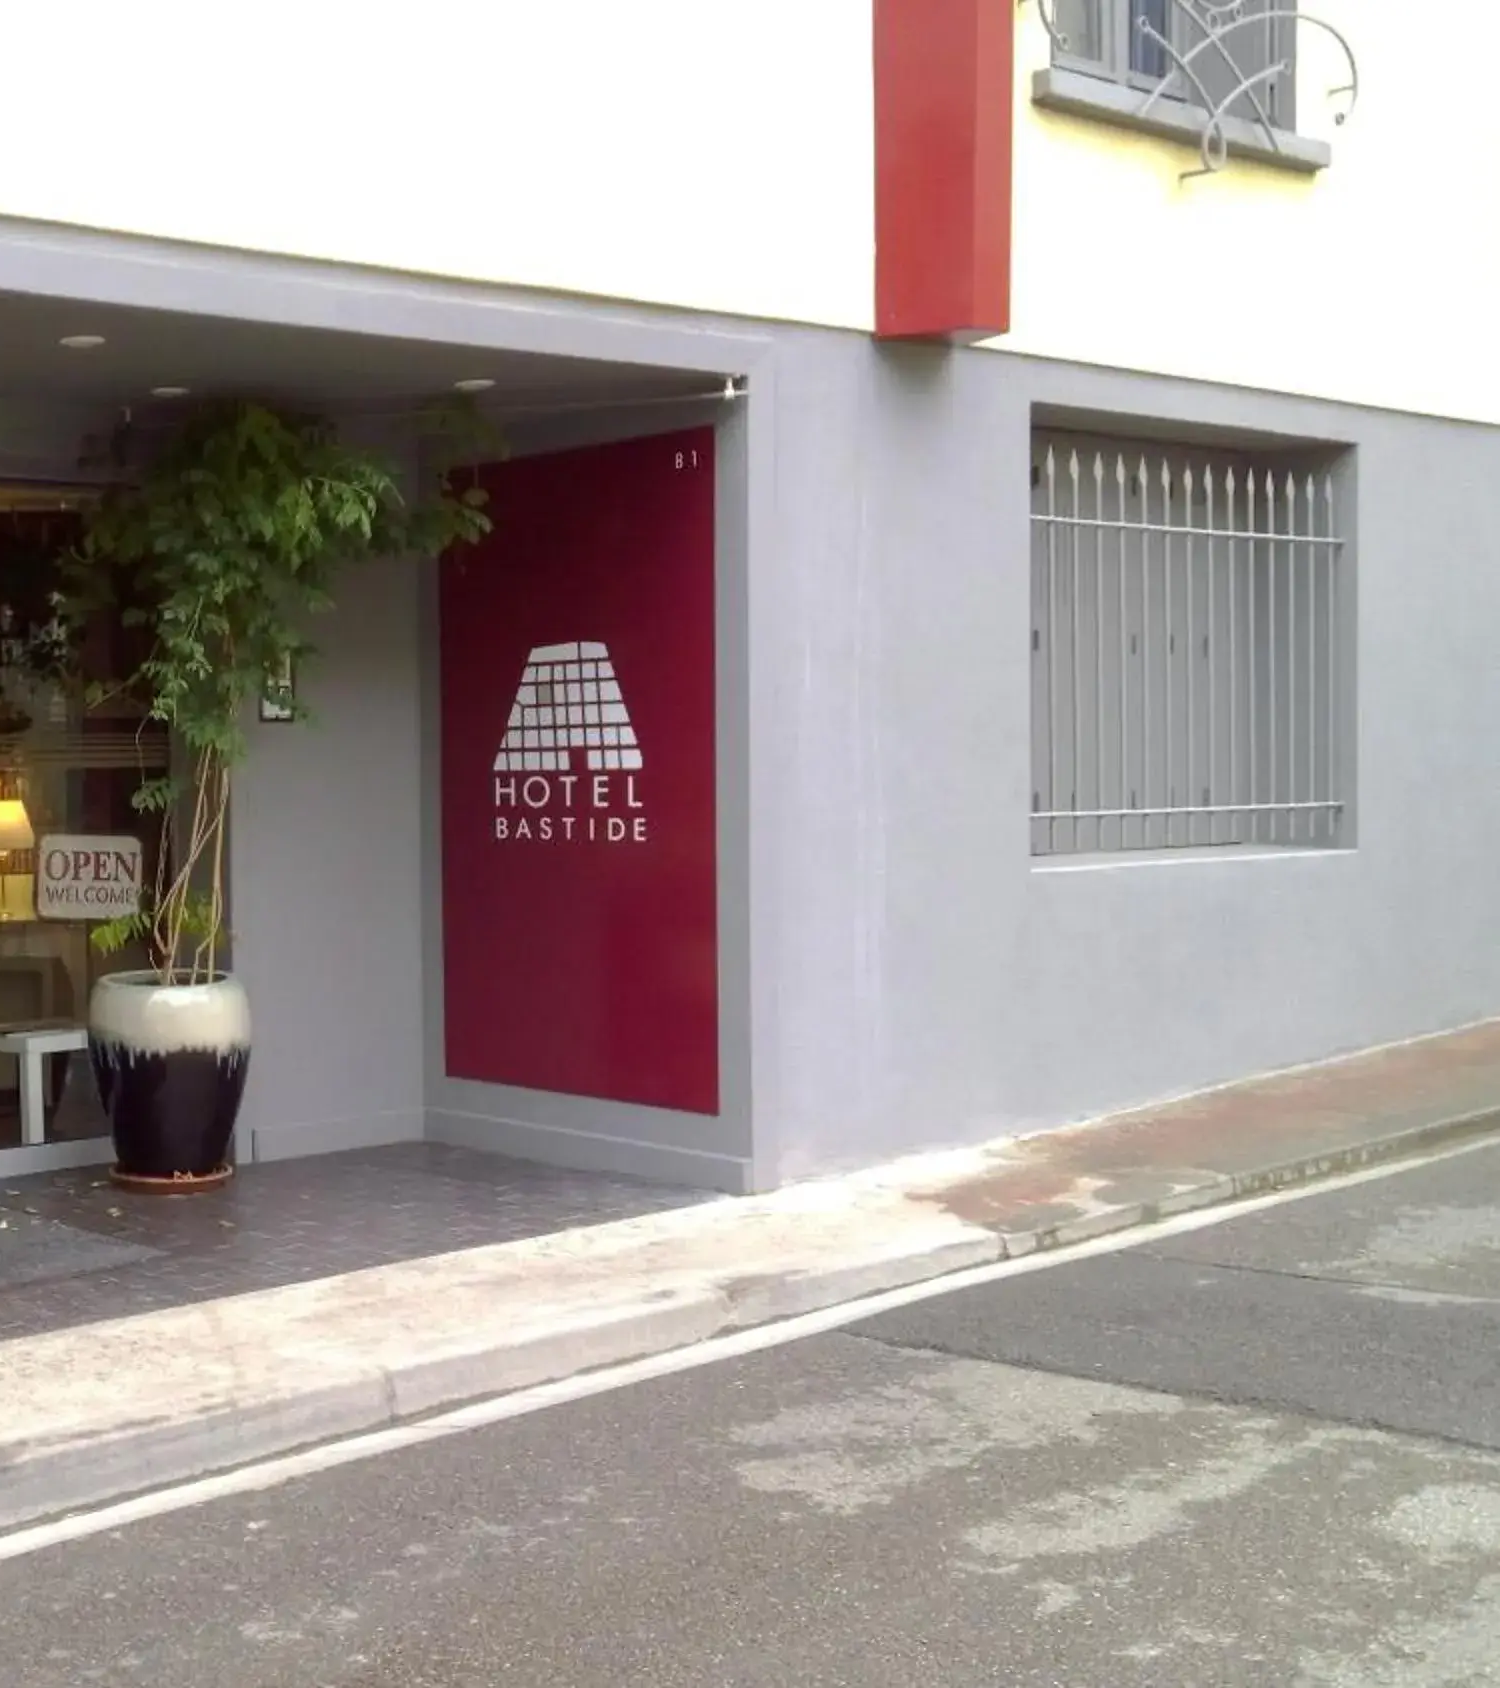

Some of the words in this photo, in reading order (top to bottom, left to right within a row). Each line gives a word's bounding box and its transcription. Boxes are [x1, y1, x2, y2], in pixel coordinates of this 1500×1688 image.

[674, 450, 698, 470] 81
[494, 775, 644, 808] HOTEL
[495, 817, 647, 841] BASTIDE
[45, 849, 138, 882] OPEN
[45, 885, 137, 906] WELCOME
